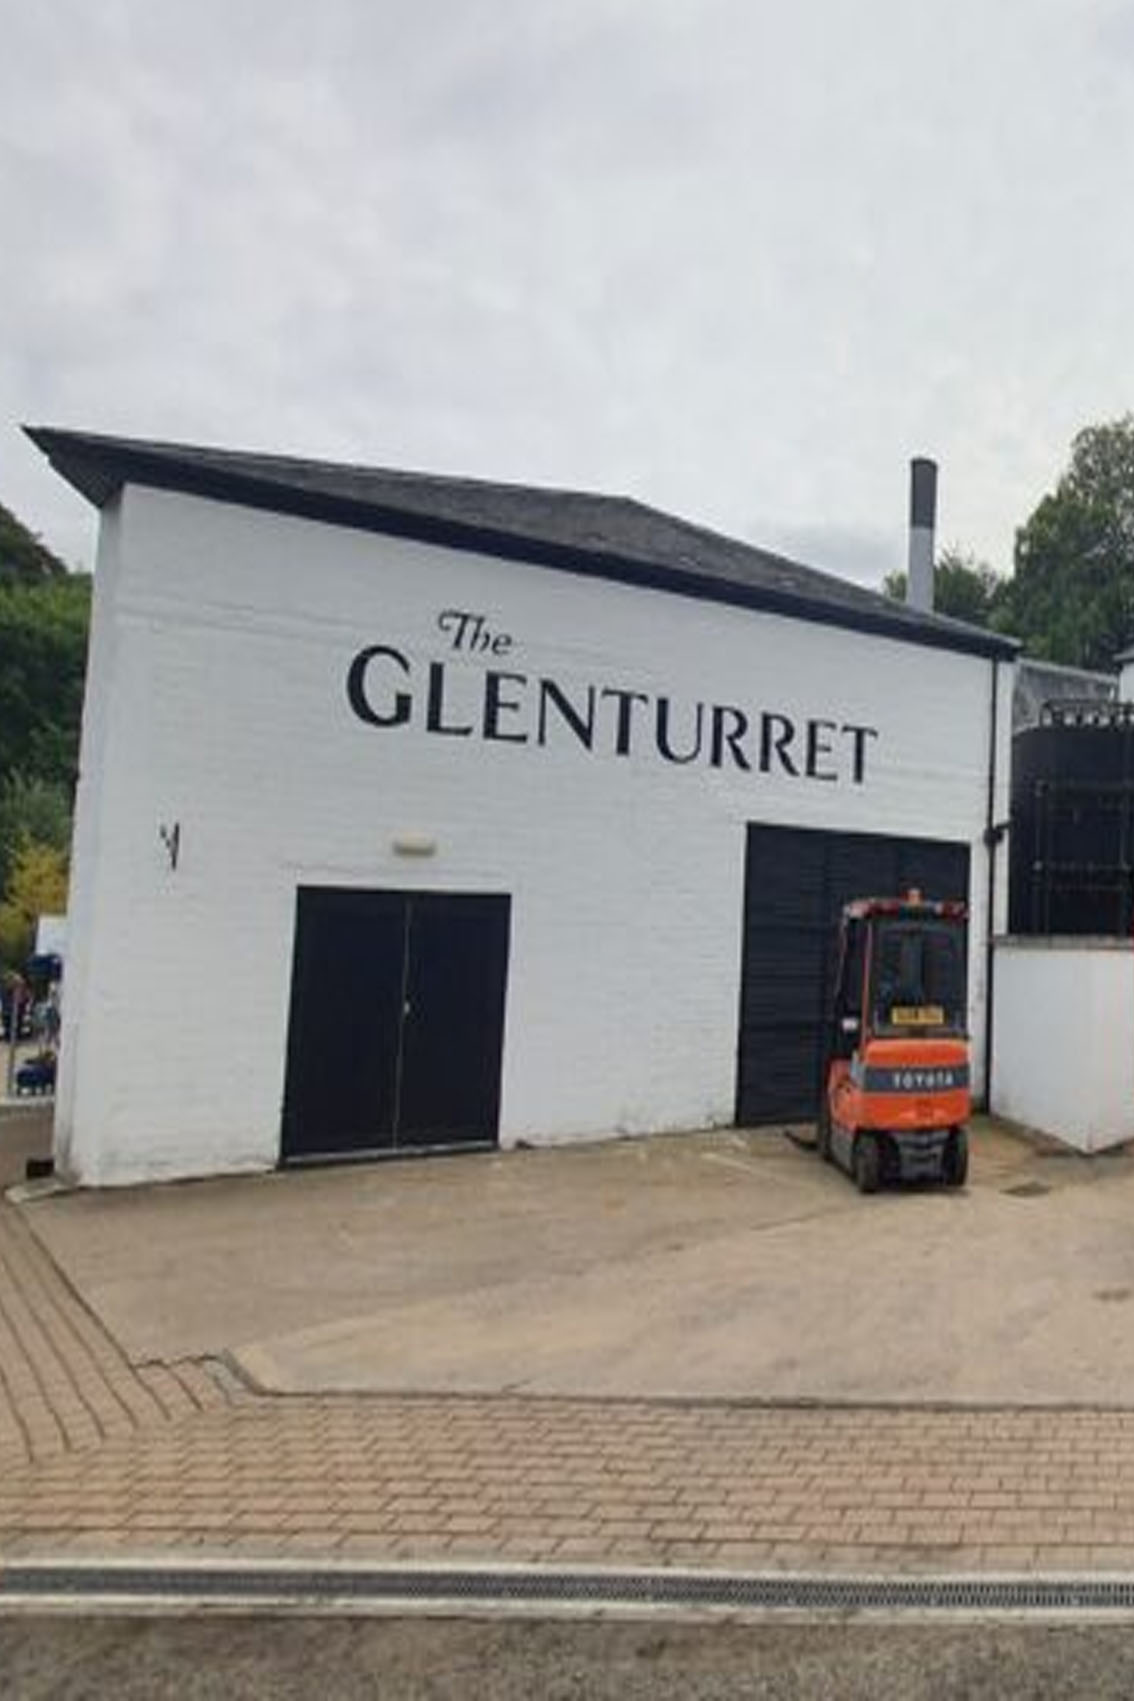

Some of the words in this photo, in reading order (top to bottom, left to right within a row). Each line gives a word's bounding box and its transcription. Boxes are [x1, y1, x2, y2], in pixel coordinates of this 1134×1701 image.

[438, 609, 512, 656] The
[346, 644, 878, 784] GLENTURRET
[893, 1071, 955, 1089] TOYOTA
